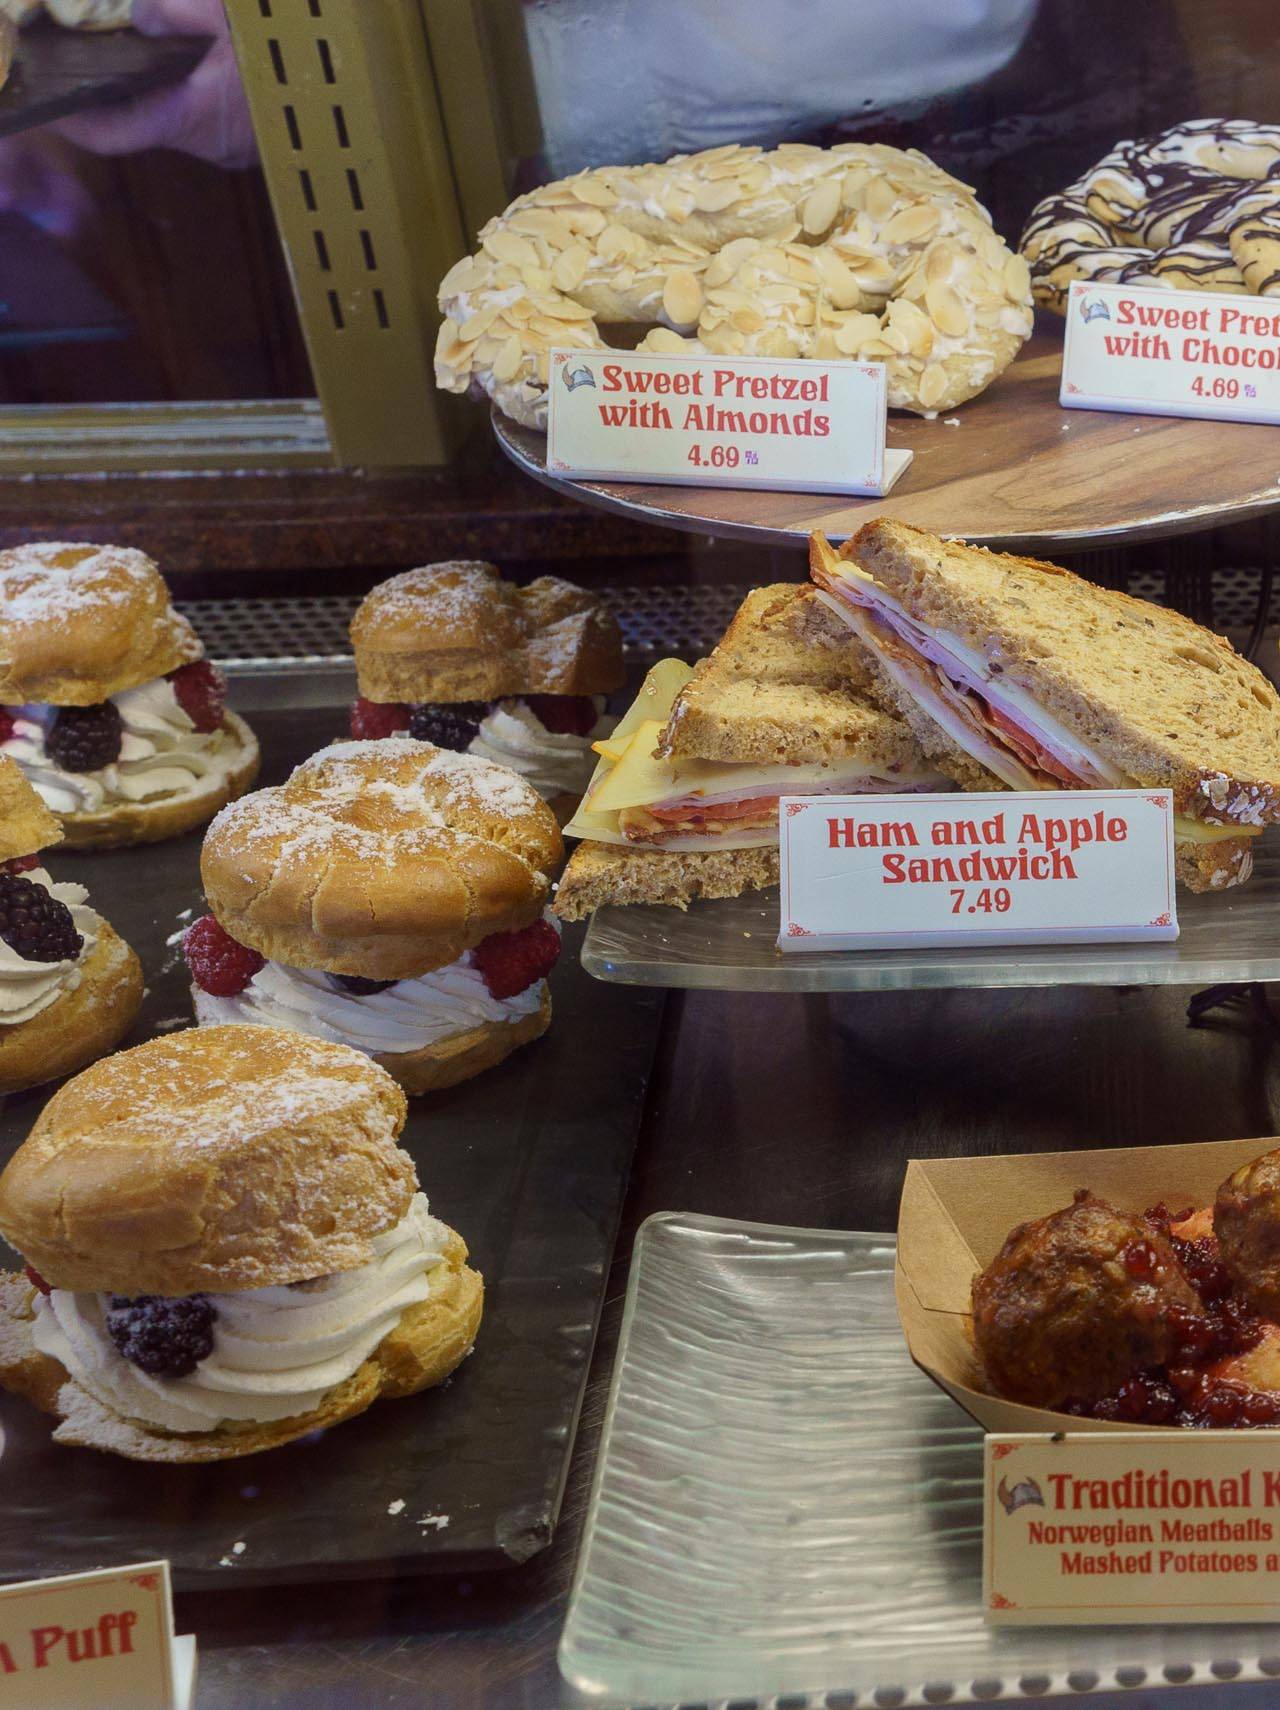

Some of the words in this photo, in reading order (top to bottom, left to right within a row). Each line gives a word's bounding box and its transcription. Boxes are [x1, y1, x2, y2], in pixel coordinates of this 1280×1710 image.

[1117, 301, 1210, 330] Sweet
[1104, 332, 1171, 360] with
[602, 365, 703, 394] Sweet
[714, 369, 829, 402] Pretzel
[1191, 377, 1239, 399] 4.69
[599, 404, 673, 430] with
[682, 405, 830, 437] Almonds
[687, 445, 740, 468] 4.69
[826, 817, 920, 848] Ham
[931, 813, 1005, 845] and
[1017, 810, 1128, 852] Apple
[882, 847, 1078, 883] Sandwich
[950, 888, 1011, 914] 7.49
[1048, 1469, 1251, 1510] Traditional
[1029, 1520, 1154, 1547] Norwegian
[1161, 1517, 1273, 1542] Meatballs
[1061, 1551, 1152, 1575] Mashed
[1159, 1551, 1258, 1573] Potatoes
[31, 1611, 137, 1668] Puff
